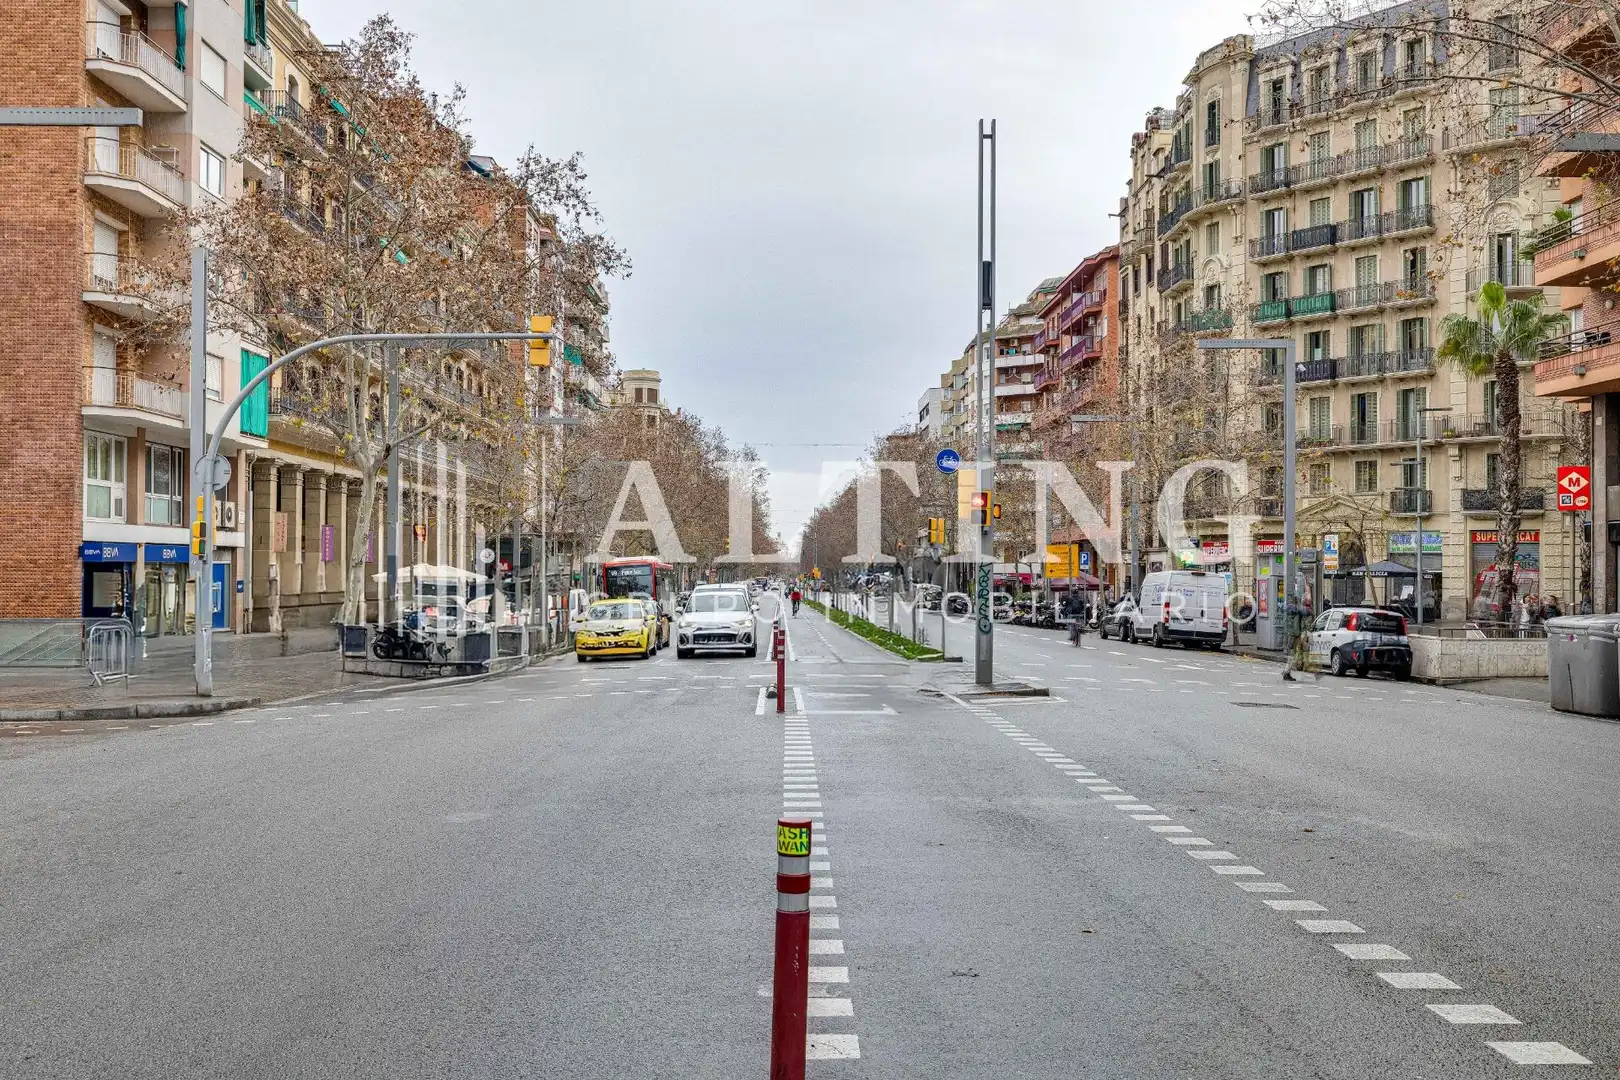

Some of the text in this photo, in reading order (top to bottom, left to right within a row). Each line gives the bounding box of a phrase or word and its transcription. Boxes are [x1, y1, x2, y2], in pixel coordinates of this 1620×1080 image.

[1568, 477, 1580, 487] M
[1476, 532, 1535, 541] SUPECAT
[103, 547, 119, 558] BBVA
[163, 549, 177, 559] BBVA
[1081, 553, 1087, 564] P
[778, 827, 808, 840] ASH
[778, 839, 808, 853] WAN
